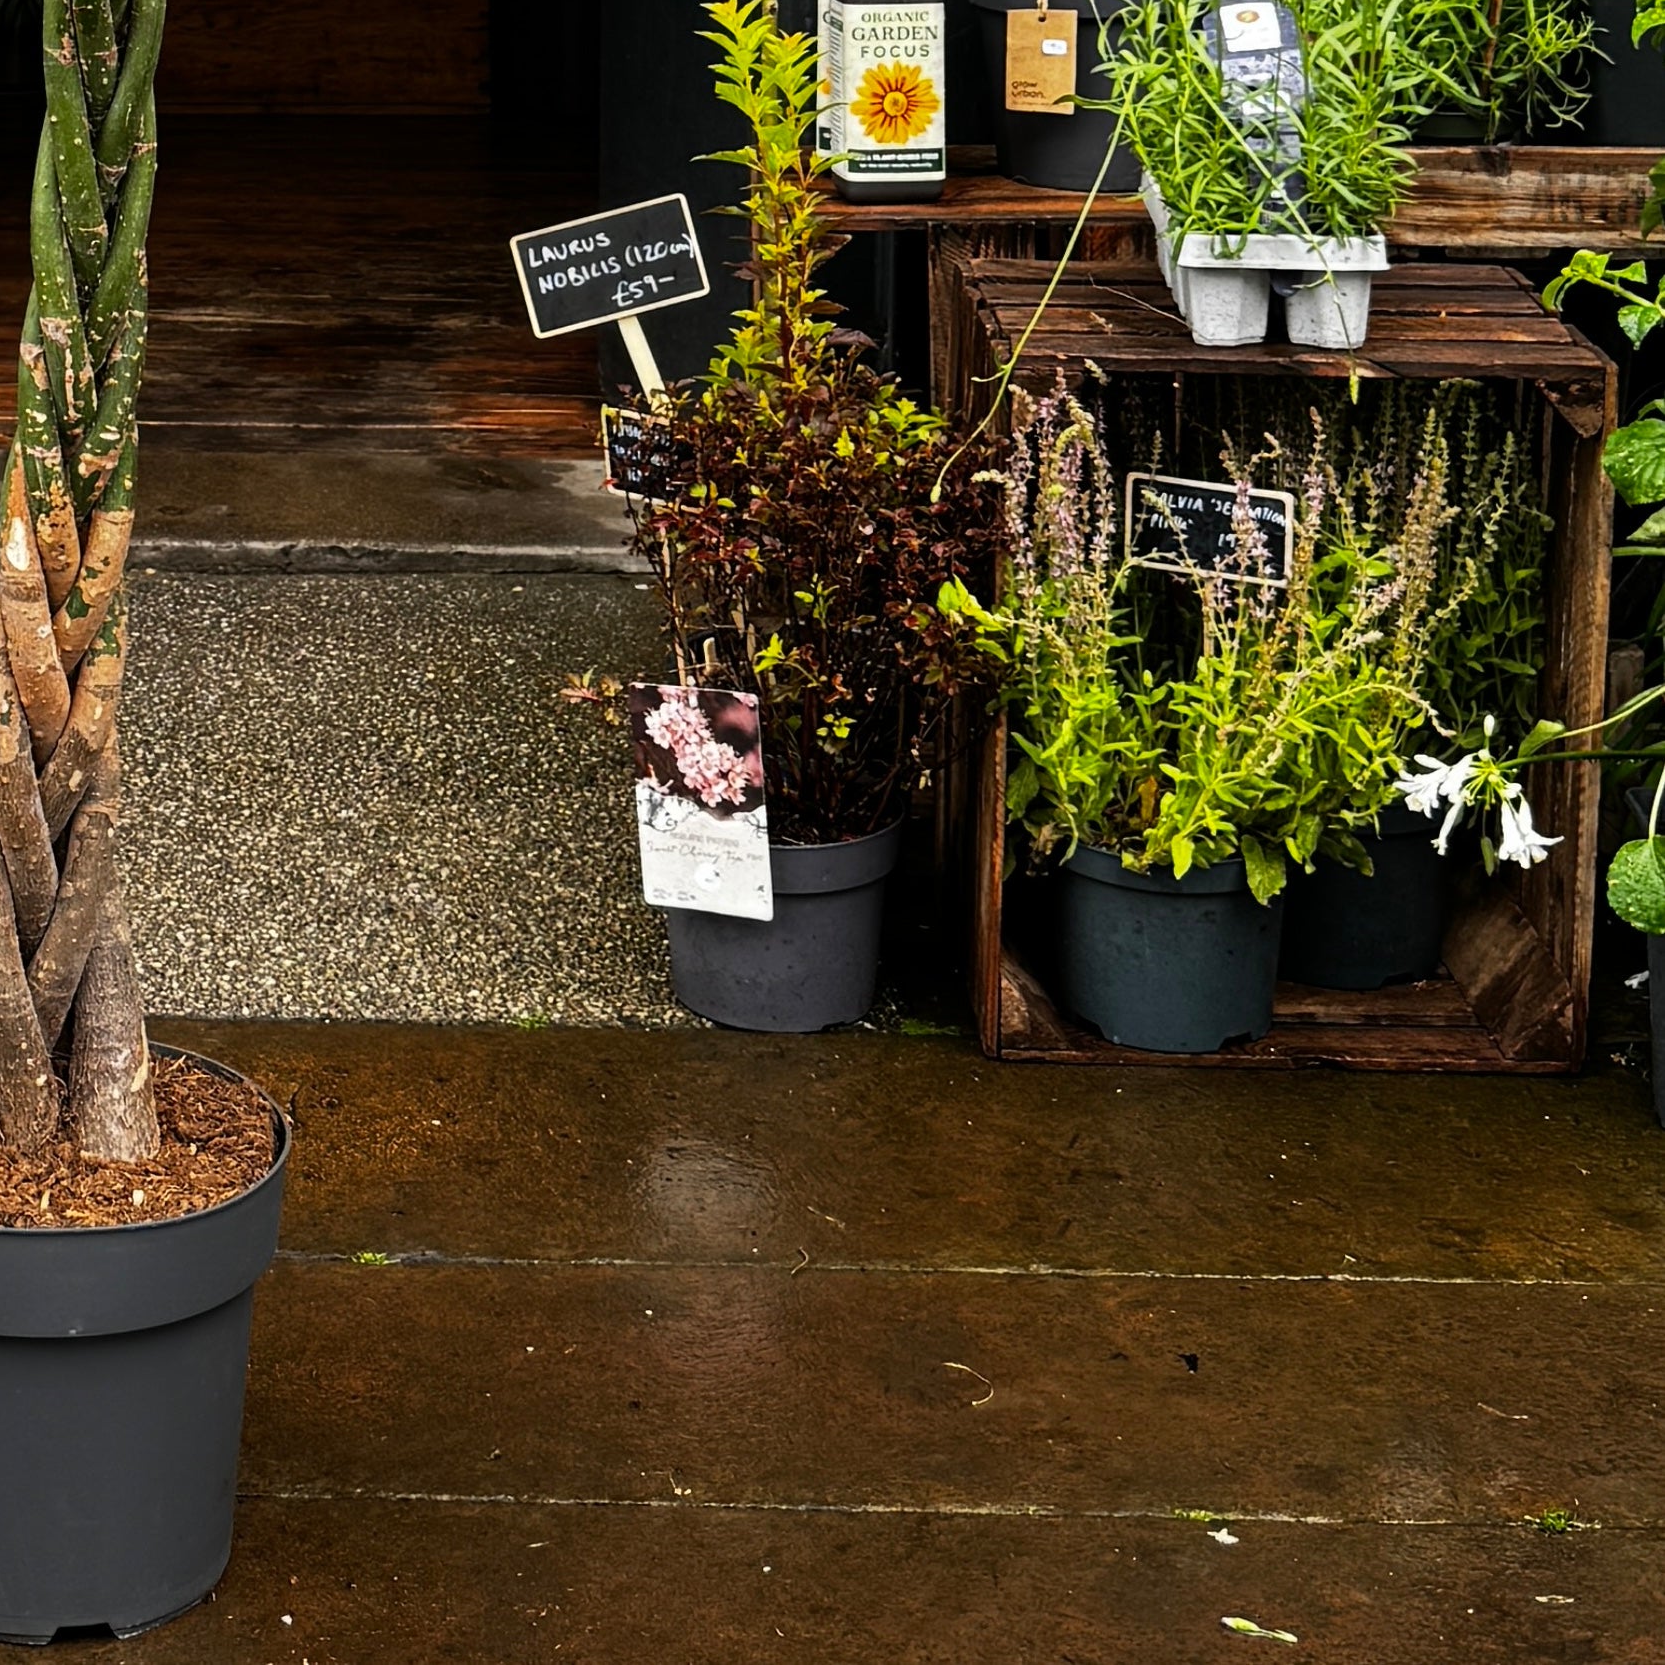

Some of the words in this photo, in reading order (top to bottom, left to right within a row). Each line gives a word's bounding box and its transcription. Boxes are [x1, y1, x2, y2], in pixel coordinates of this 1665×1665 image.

[860, 10, 931, 24] ORGANIC
[851, 25, 939, 42] GARDEN
[860, 44, 931, 59] FOCUS
[527, 232, 612, 269] LAURUS
[537, 256, 622, 295] NOBILIS
